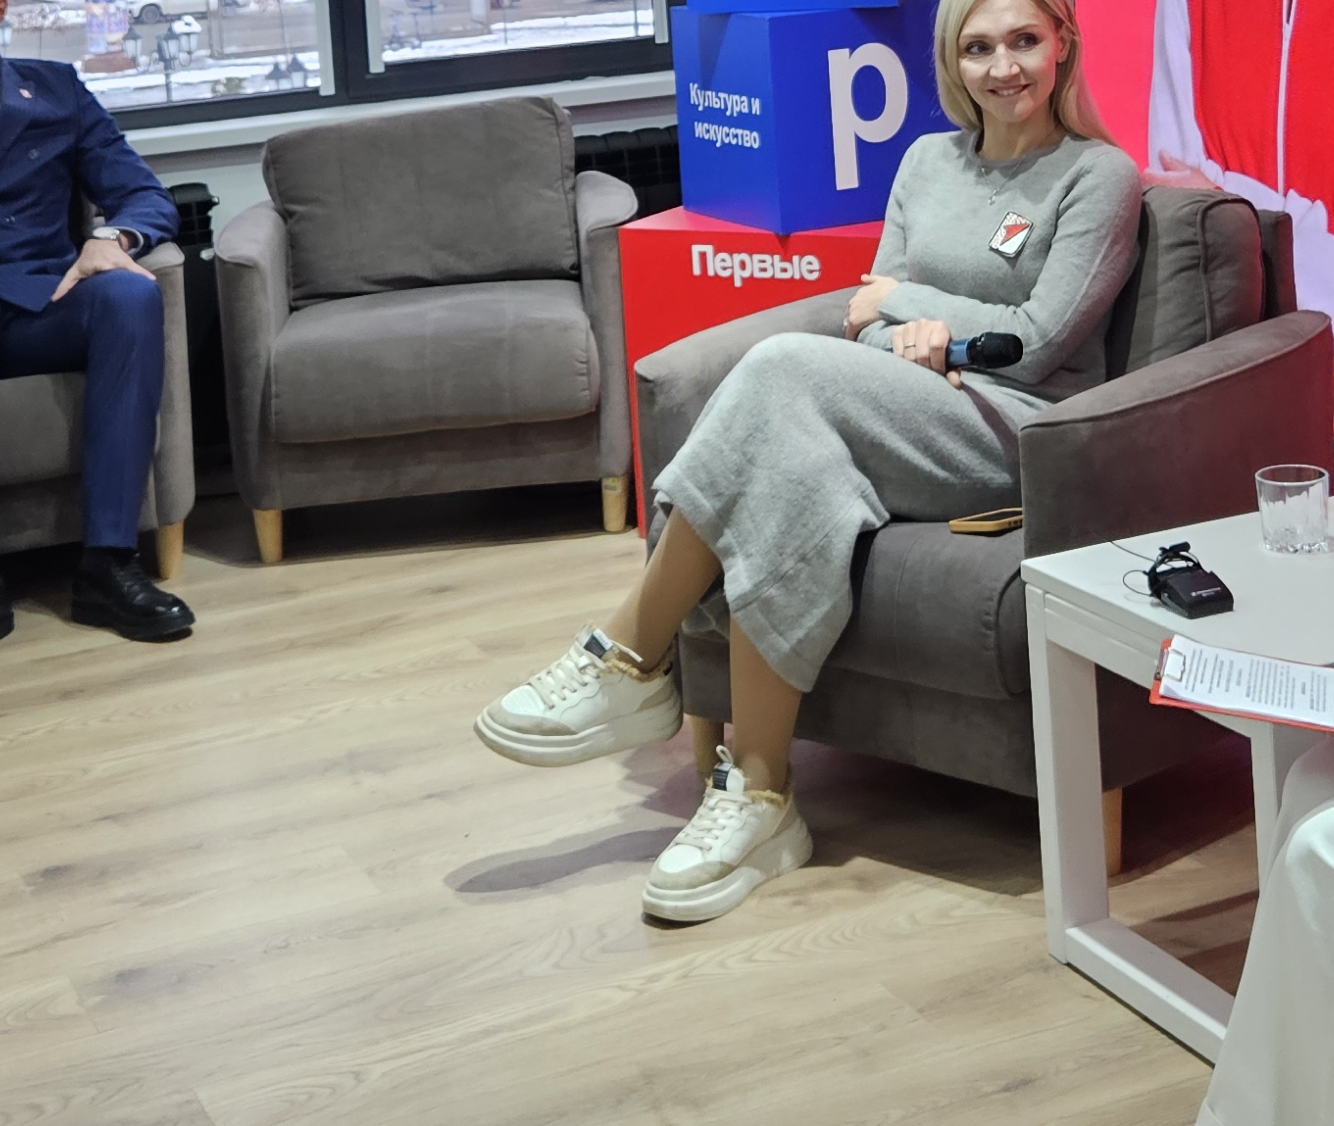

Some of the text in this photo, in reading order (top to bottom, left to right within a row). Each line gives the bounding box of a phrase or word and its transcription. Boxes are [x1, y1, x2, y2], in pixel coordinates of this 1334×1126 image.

[689, 82, 760, 117] Культура и
[694, 121, 760, 149] искусство
[690, 243, 821, 286] Первые
